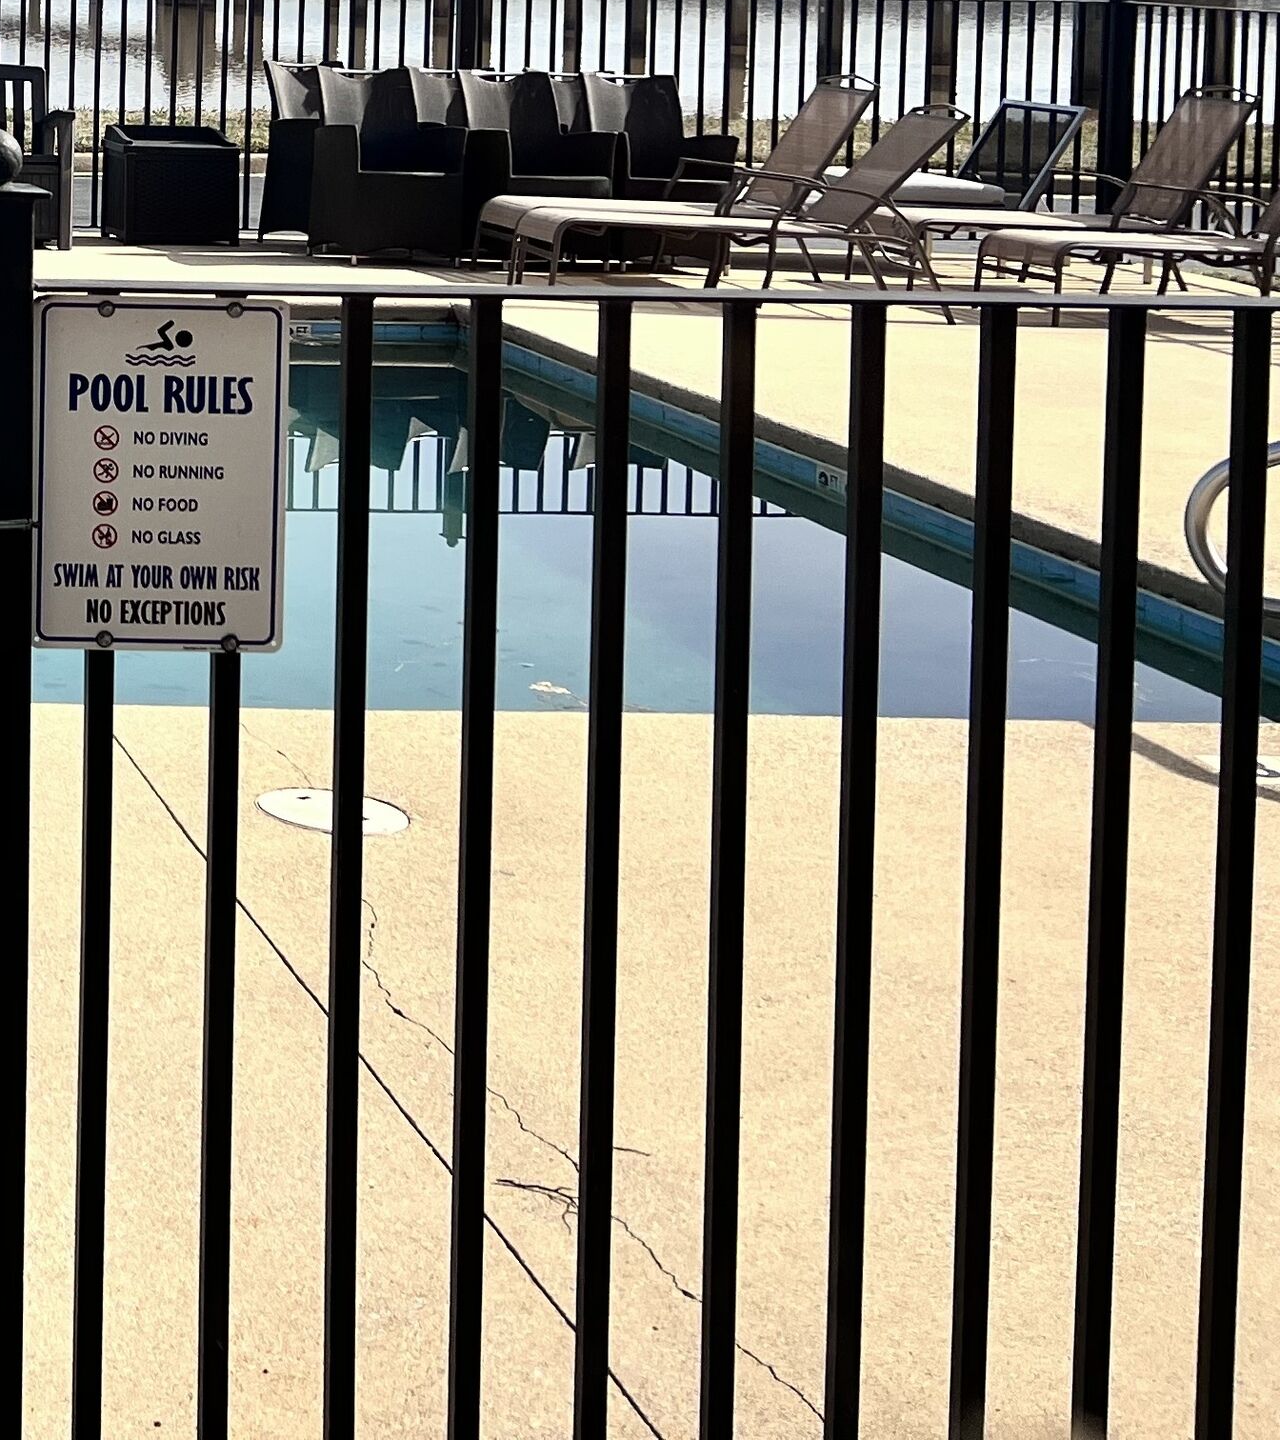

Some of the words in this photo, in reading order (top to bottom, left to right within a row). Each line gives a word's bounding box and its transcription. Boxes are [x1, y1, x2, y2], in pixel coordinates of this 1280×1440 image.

[68, 373, 149, 413] POOL
[163, 375, 255, 416] RULES
[133, 431, 156, 446] NO
[159, 431, 209, 447] DIVING
[132, 464, 155, 479] NO
[158, 465, 225, 480] RUNNING
[132, 497, 154, 512] NO
[158, 498, 198, 512] FOOD
[131, 530, 154, 544] NO
[157, 530, 201, 545] GLASS
[53, 564, 99, 588] SWIM
[106, 564, 124, 588] AT
[131, 565, 172, 589] YOUR
[179, 566, 217, 590] OWN
[223, 567, 260, 591] RISK
[86, 599, 112, 623] NO
[120, 600, 226, 626] EXCEPTIONS
